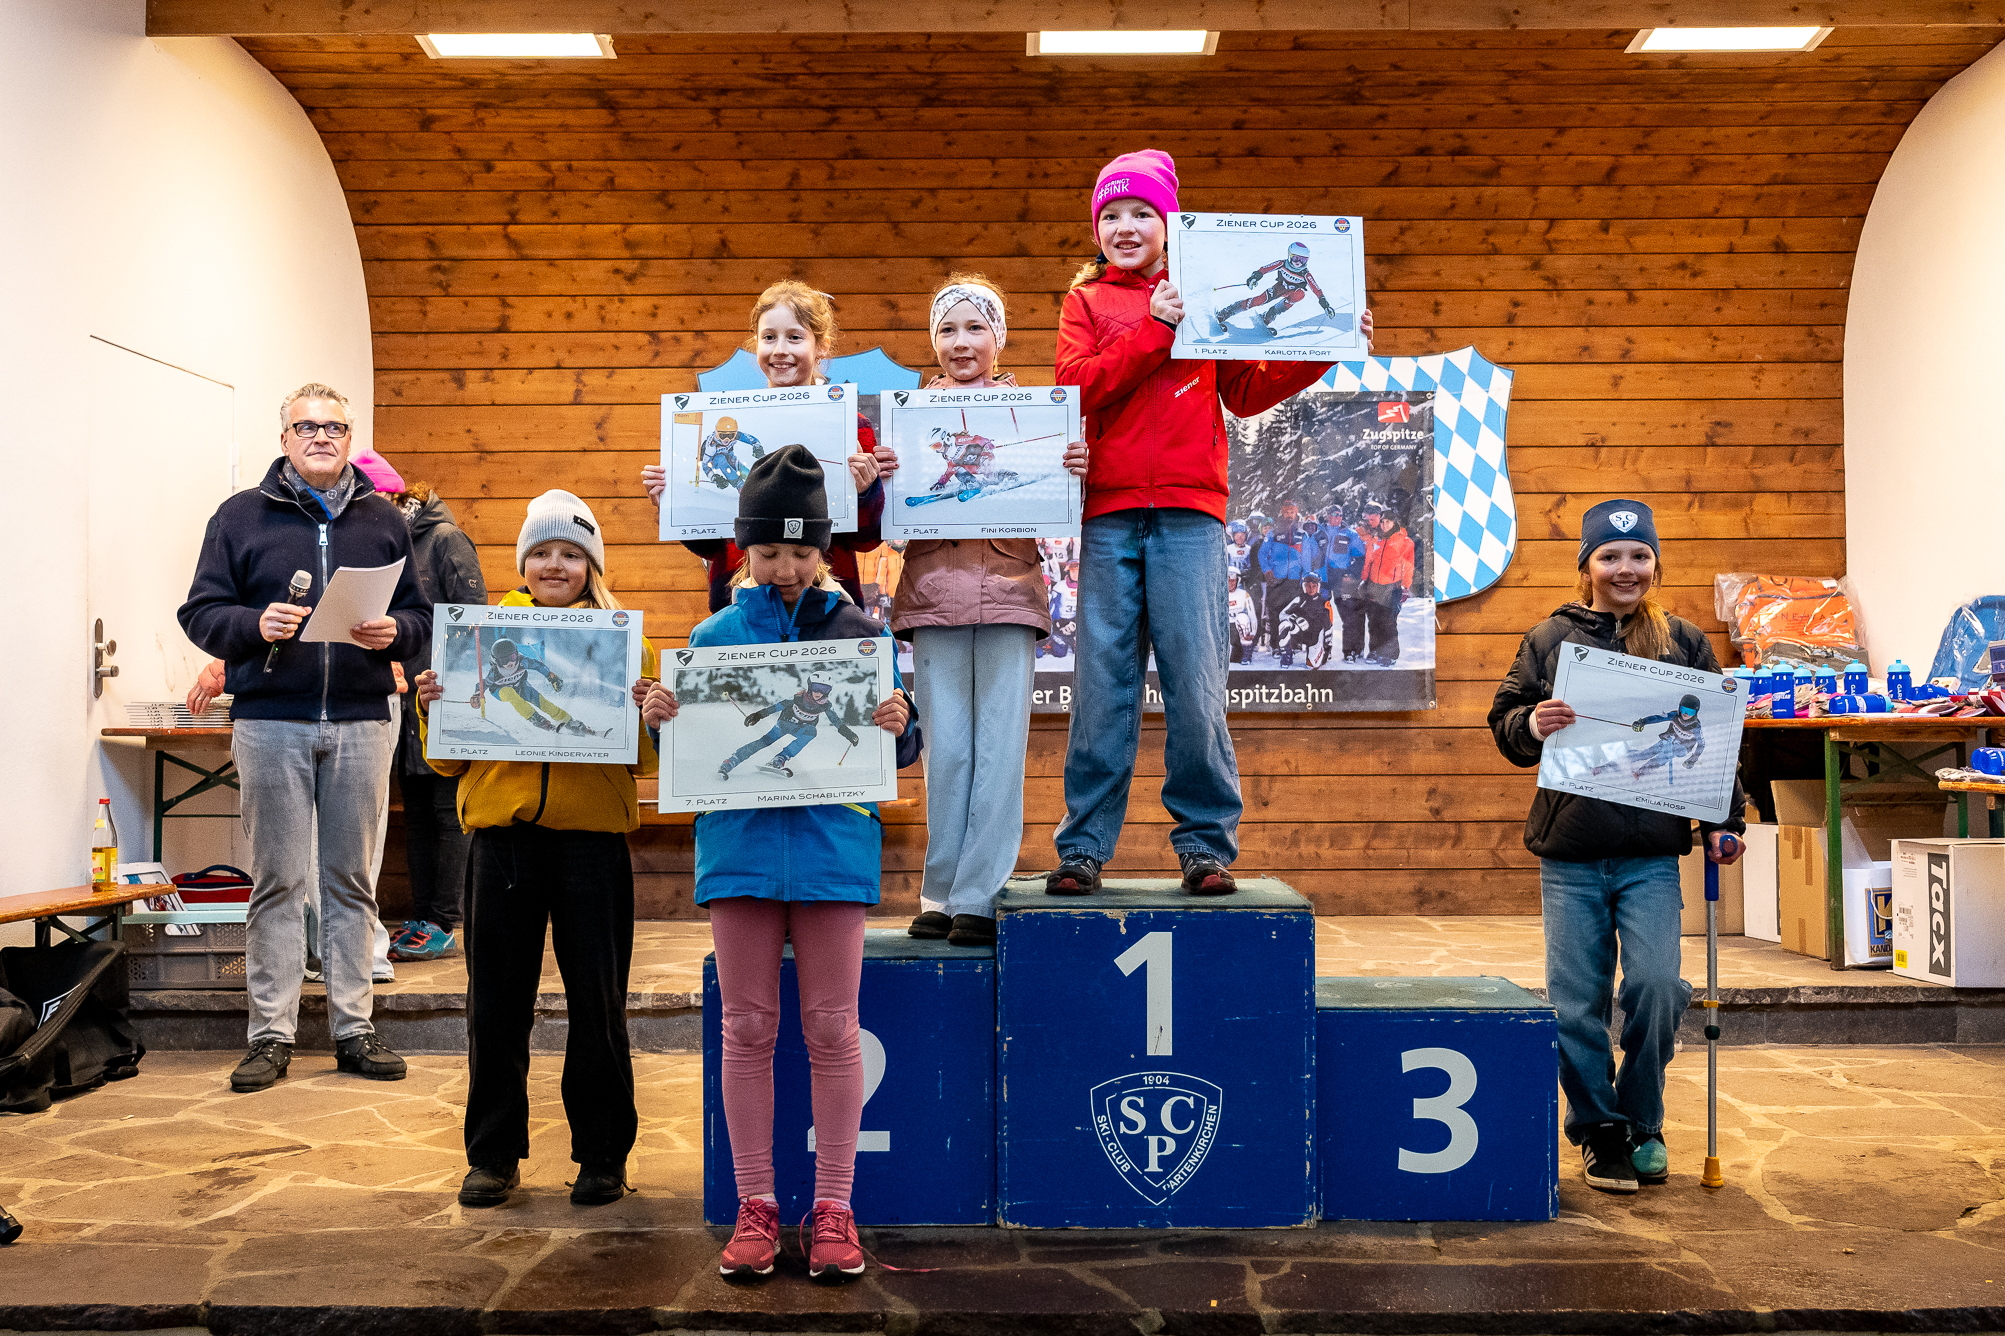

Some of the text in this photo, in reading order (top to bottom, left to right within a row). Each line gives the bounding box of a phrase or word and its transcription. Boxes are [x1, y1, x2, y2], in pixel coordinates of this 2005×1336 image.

[1096, 183, 1130, 203] #PINK
[1216, 219, 1317, 229] ZIENER CUP 2026
[1174, 376, 1200, 398] ziener
[709, 391, 810, 405] ZIENER CUP 2026
[929, 392, 1033, 403] ZIENER CUP 2026
[1362, 428, 1424, 443] Zugspitze
[486, 611, 594, 623] ZIENER CUP 2026
[717, 646, 837, 661] ZIENER CUP 2026
[1607, 657, 1705, 684] ZIENER CUP 2026
[1032, 689, 1054, 705] er
[1225, 683, 1334, 709] spitzbahn
[460, 747, 488, 755] PLATZ
[515, 749, 609, 758] LEONIE KINDERVATER
[1568, 782, 1594, 793] PLATZ
[696, 798, 728, 806] PLATZ
[757, 790, 866, 802] MARINA SCHABLITZKY
[1635, 796, 1686, 811] EMILIA HOSP
[1930, 861, 1948, 969] Tacx
[1114, 931, 1173, 1056] 1
[1142, 1075, 1170, 1085] 1904
[1398, 1047, 1479, 1174] 3
